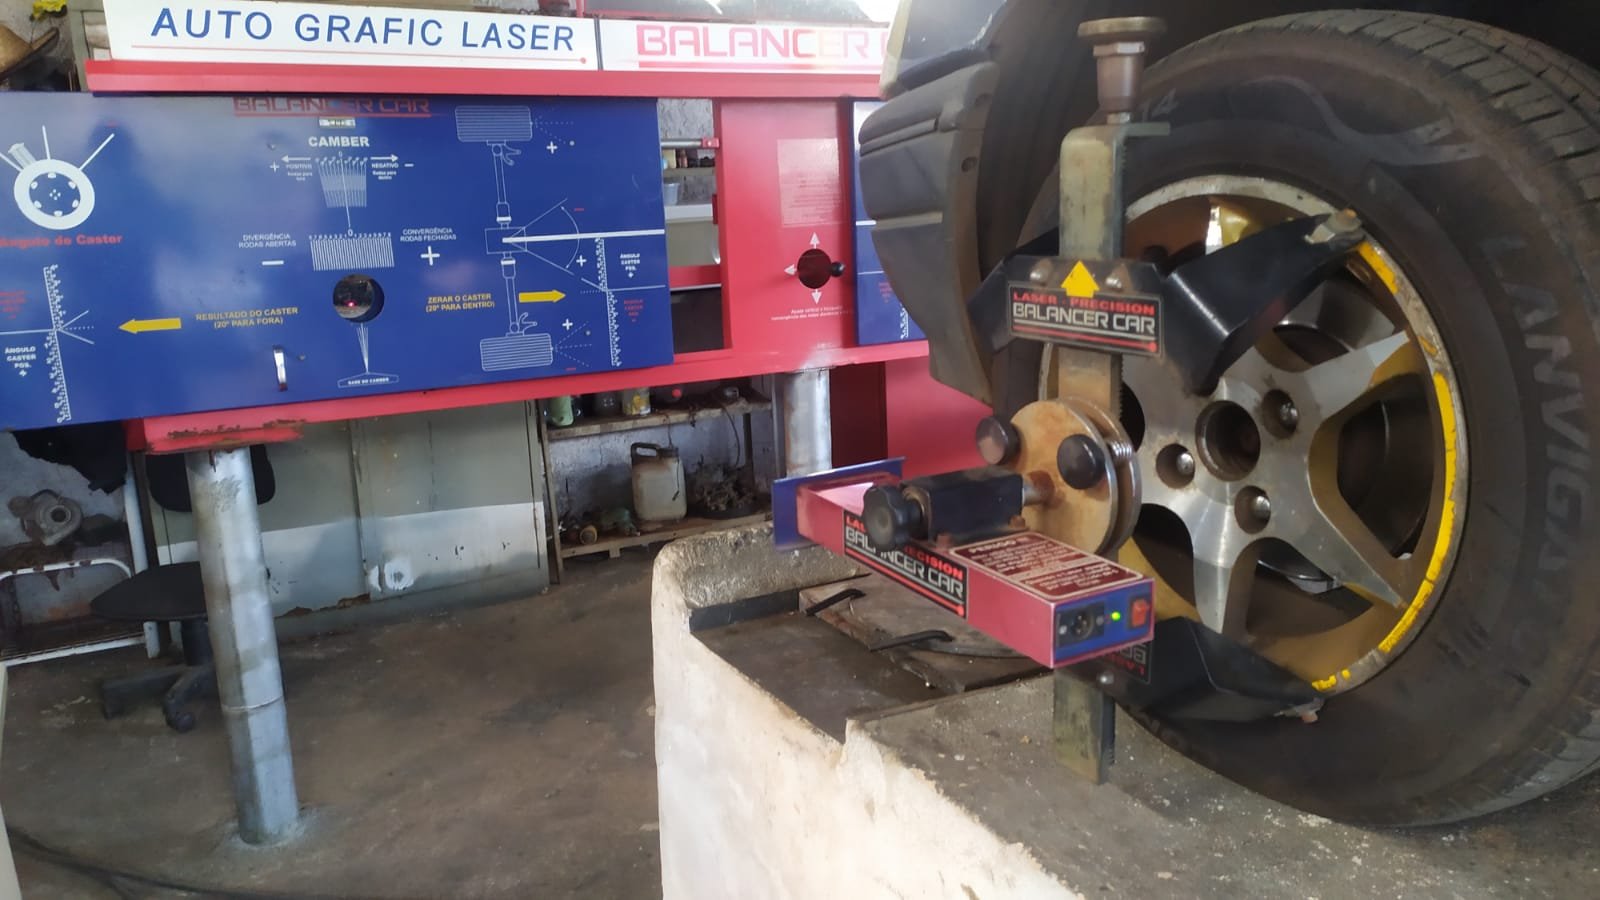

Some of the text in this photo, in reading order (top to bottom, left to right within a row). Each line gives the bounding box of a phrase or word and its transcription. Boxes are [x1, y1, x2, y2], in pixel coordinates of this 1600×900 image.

[151, 7, 575, 51] AUTO GRAFIC LASER
[636, 24, 869, 58] BALANCER
[232, 97, 372, 113] BALANR
[308, 136, 370, 147] CAMBER
[347, 228, 354, 237] 0
[402, 226, 453, 235] CONVERGÊNCIA
[428, 296, 453, 304] ZERAR
[462, 293, 492, 302] CASTER
[1013, 291, 1155, 315] LASER PRECISION
[441, 303, 461, 311] PARA
[462, 301, 495, 310] DENTRO)
[195, 307, 298, 320] RESULTADO DO CASTER
[1013, 302, 1155, 334] BALANCER CAR
[231, 319, 254, 327] PARA
[256, 317, 284, 325] FORA)
[5, 346, 36, 354] ÂNGULO
[7, 353, 36, 362] CASTER
[845, 526, 925, 579] BALNCER
[927, 566, 964, 599] CAR
